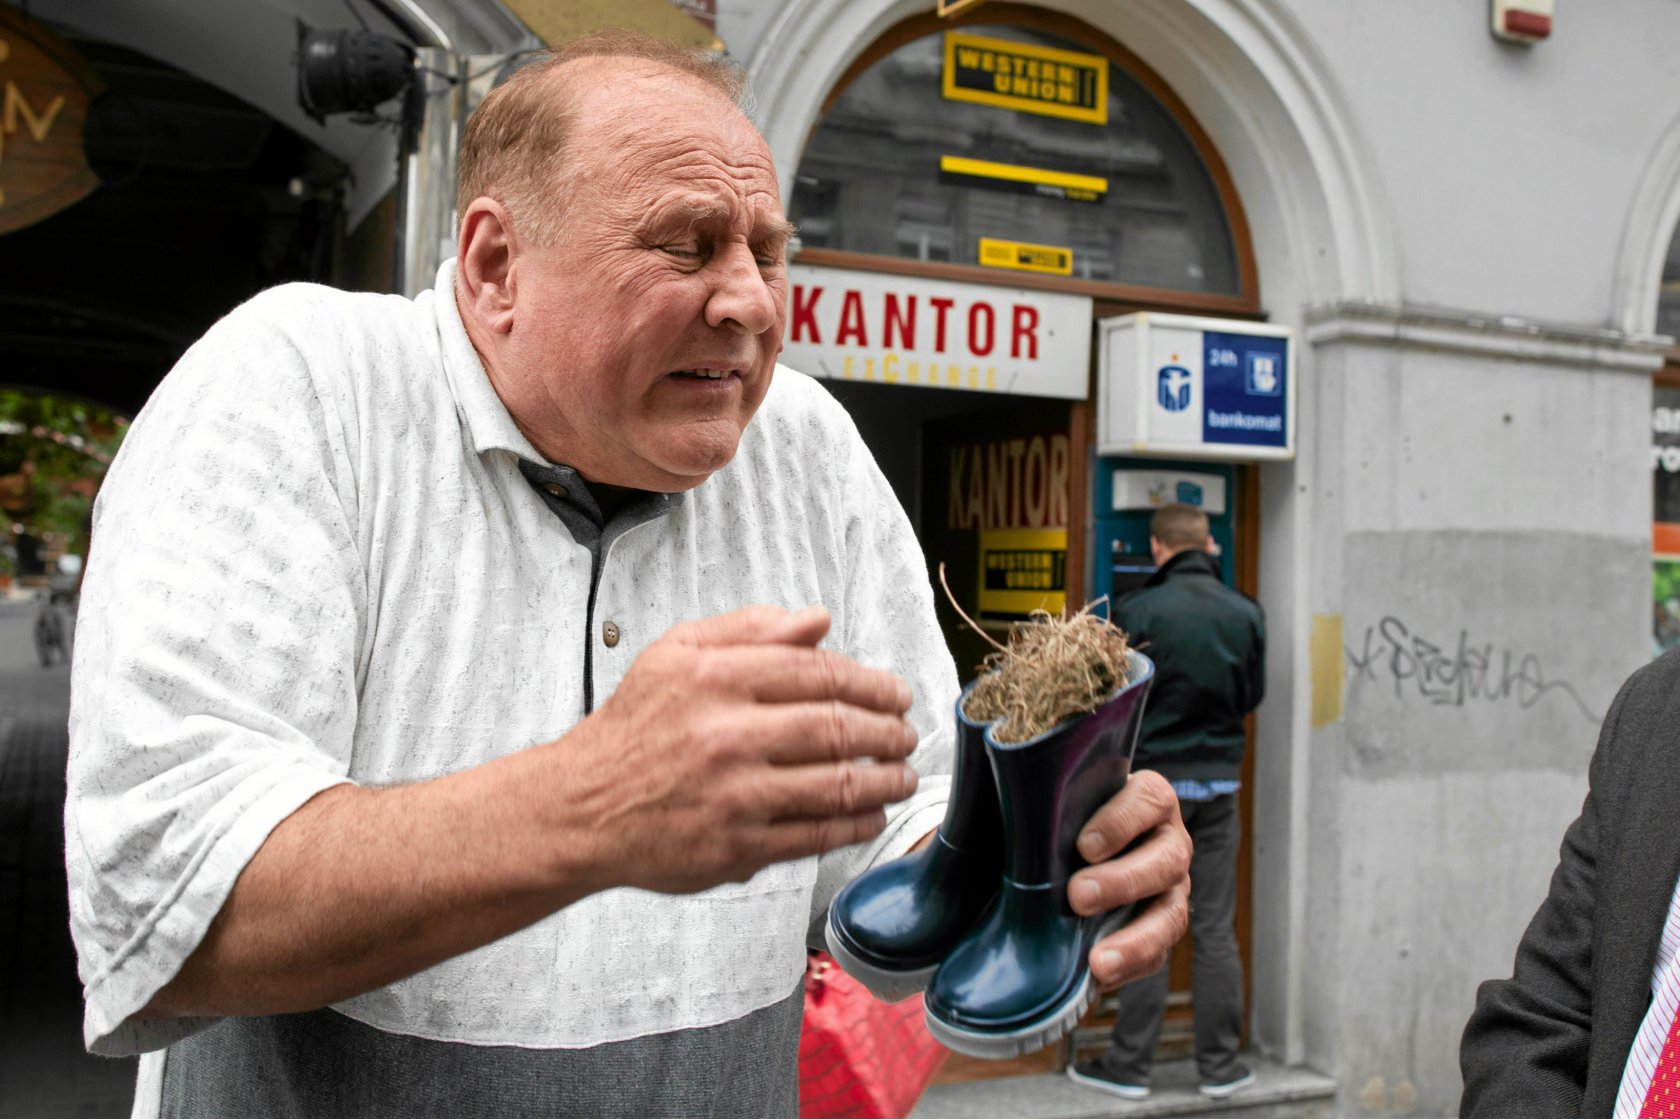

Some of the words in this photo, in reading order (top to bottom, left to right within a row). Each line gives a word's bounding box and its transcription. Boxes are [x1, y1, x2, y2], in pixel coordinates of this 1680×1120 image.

[958, 47, 1079, 82] WESTERN
[994, 73, 1079, 104] UNION
[790, 284, 1041, 360] KANTOR
[1208, 347, 1239, 368] 24h
[1207, 409, 1283, 432] bankomat
[949, 434, 1070, 530] KANTOR
[987, 552, 1053, 570] WESTERN
[1005, 571, 1053, 588] UNION
